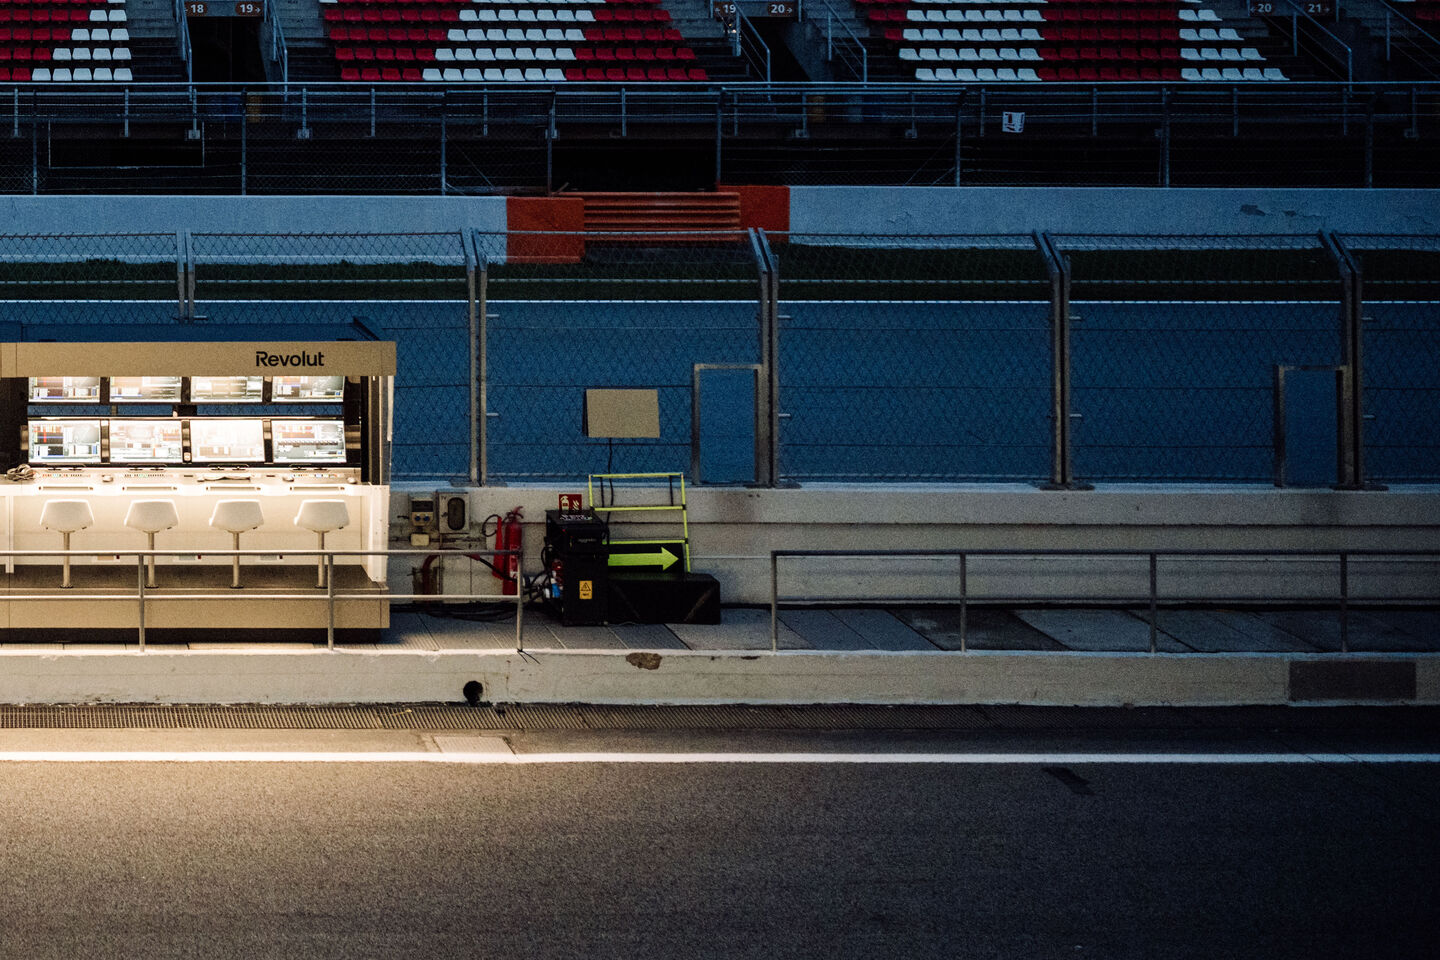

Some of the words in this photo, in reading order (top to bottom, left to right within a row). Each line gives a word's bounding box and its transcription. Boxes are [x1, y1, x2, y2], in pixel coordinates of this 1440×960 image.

[190, 4, 204, 13] 18
[240, 4, 253, 13] 19
[723, 4, 737, 13] 19
[771, 4, 785, 13] 20
[1257, 3, 1272, 13] 20
[1307, 3, 1322, 13] 21
[255, 350, 325, 367] Revolut
